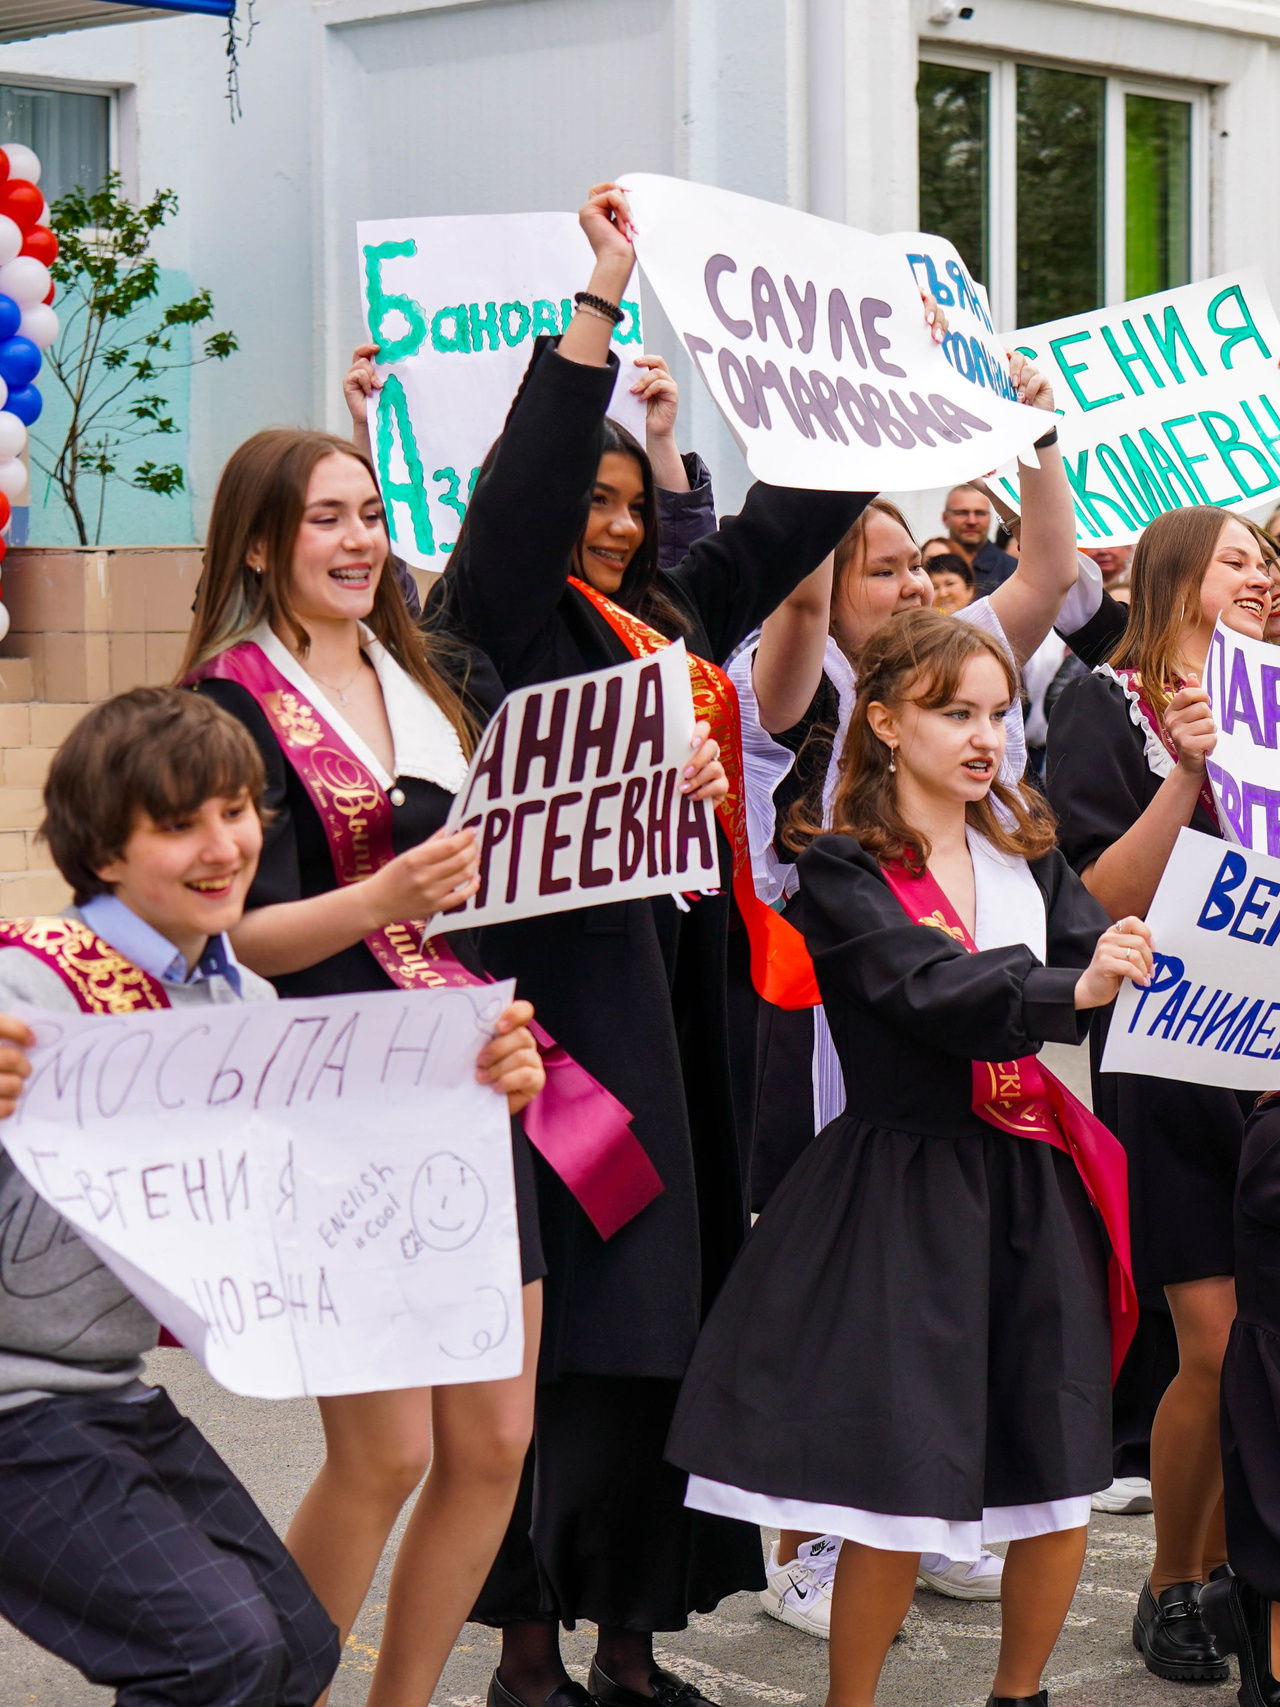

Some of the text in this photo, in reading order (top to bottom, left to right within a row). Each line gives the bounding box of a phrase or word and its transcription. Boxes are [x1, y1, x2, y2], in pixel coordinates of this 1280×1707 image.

[704, 254, 907, 378] САУЛЕ
[461, 662, 665, 817] АННА
[27, 1139, 298, 1230] ЕВГЕНИЯ
[811, 1540, 826, 1553] NIKE
